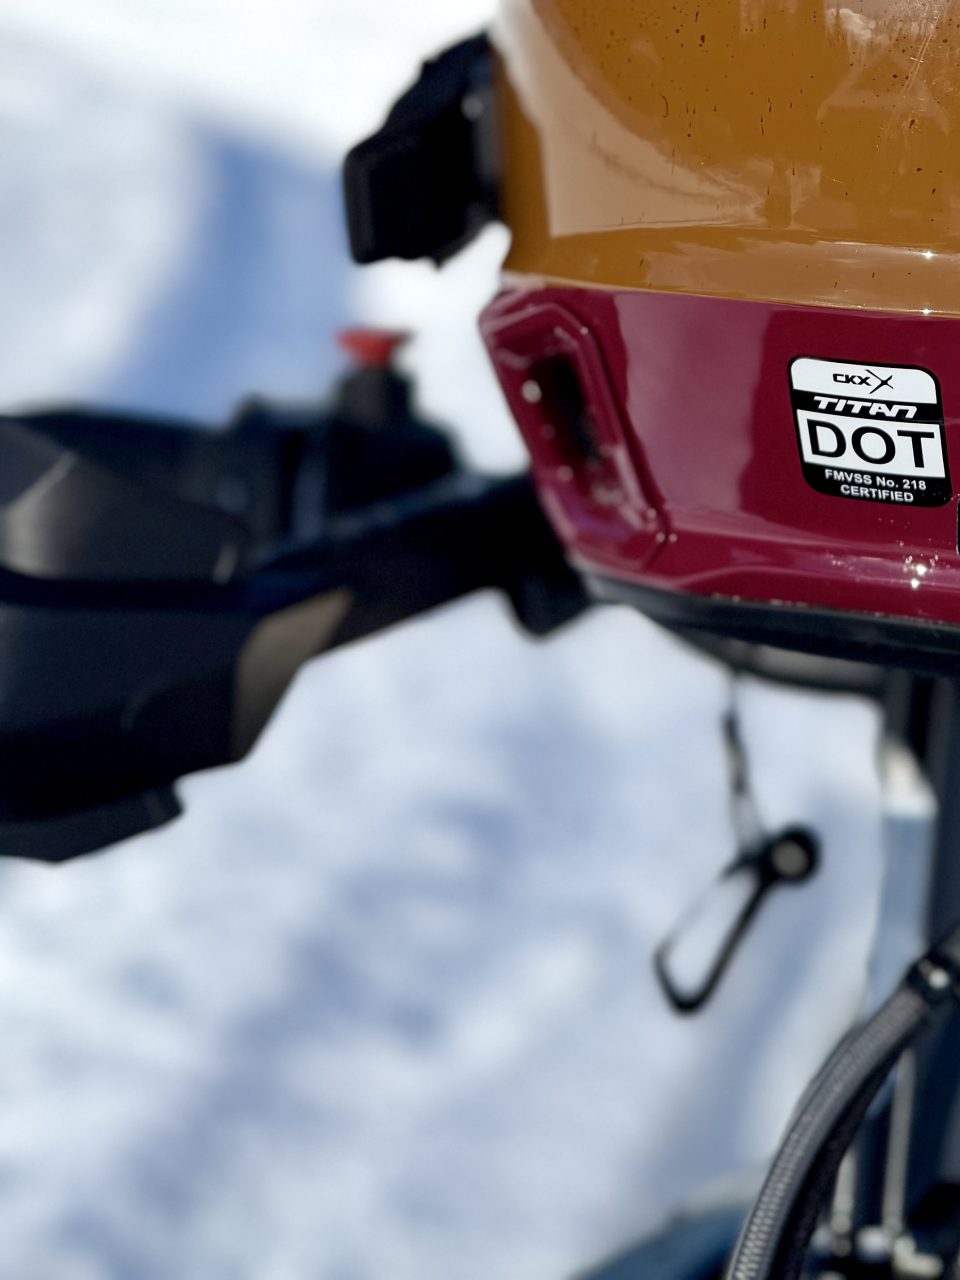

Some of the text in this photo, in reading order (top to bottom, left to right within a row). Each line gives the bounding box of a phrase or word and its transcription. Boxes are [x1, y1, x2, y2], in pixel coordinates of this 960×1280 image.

[832, 373, 873, 387] CKX
[813, 395, 918, 419] TITAN
[806, 418, 935, 469] DOT
[824, 469, 927, 491] FMVSS No. 218
[840, 484, 914, 503] CERTIFIED
